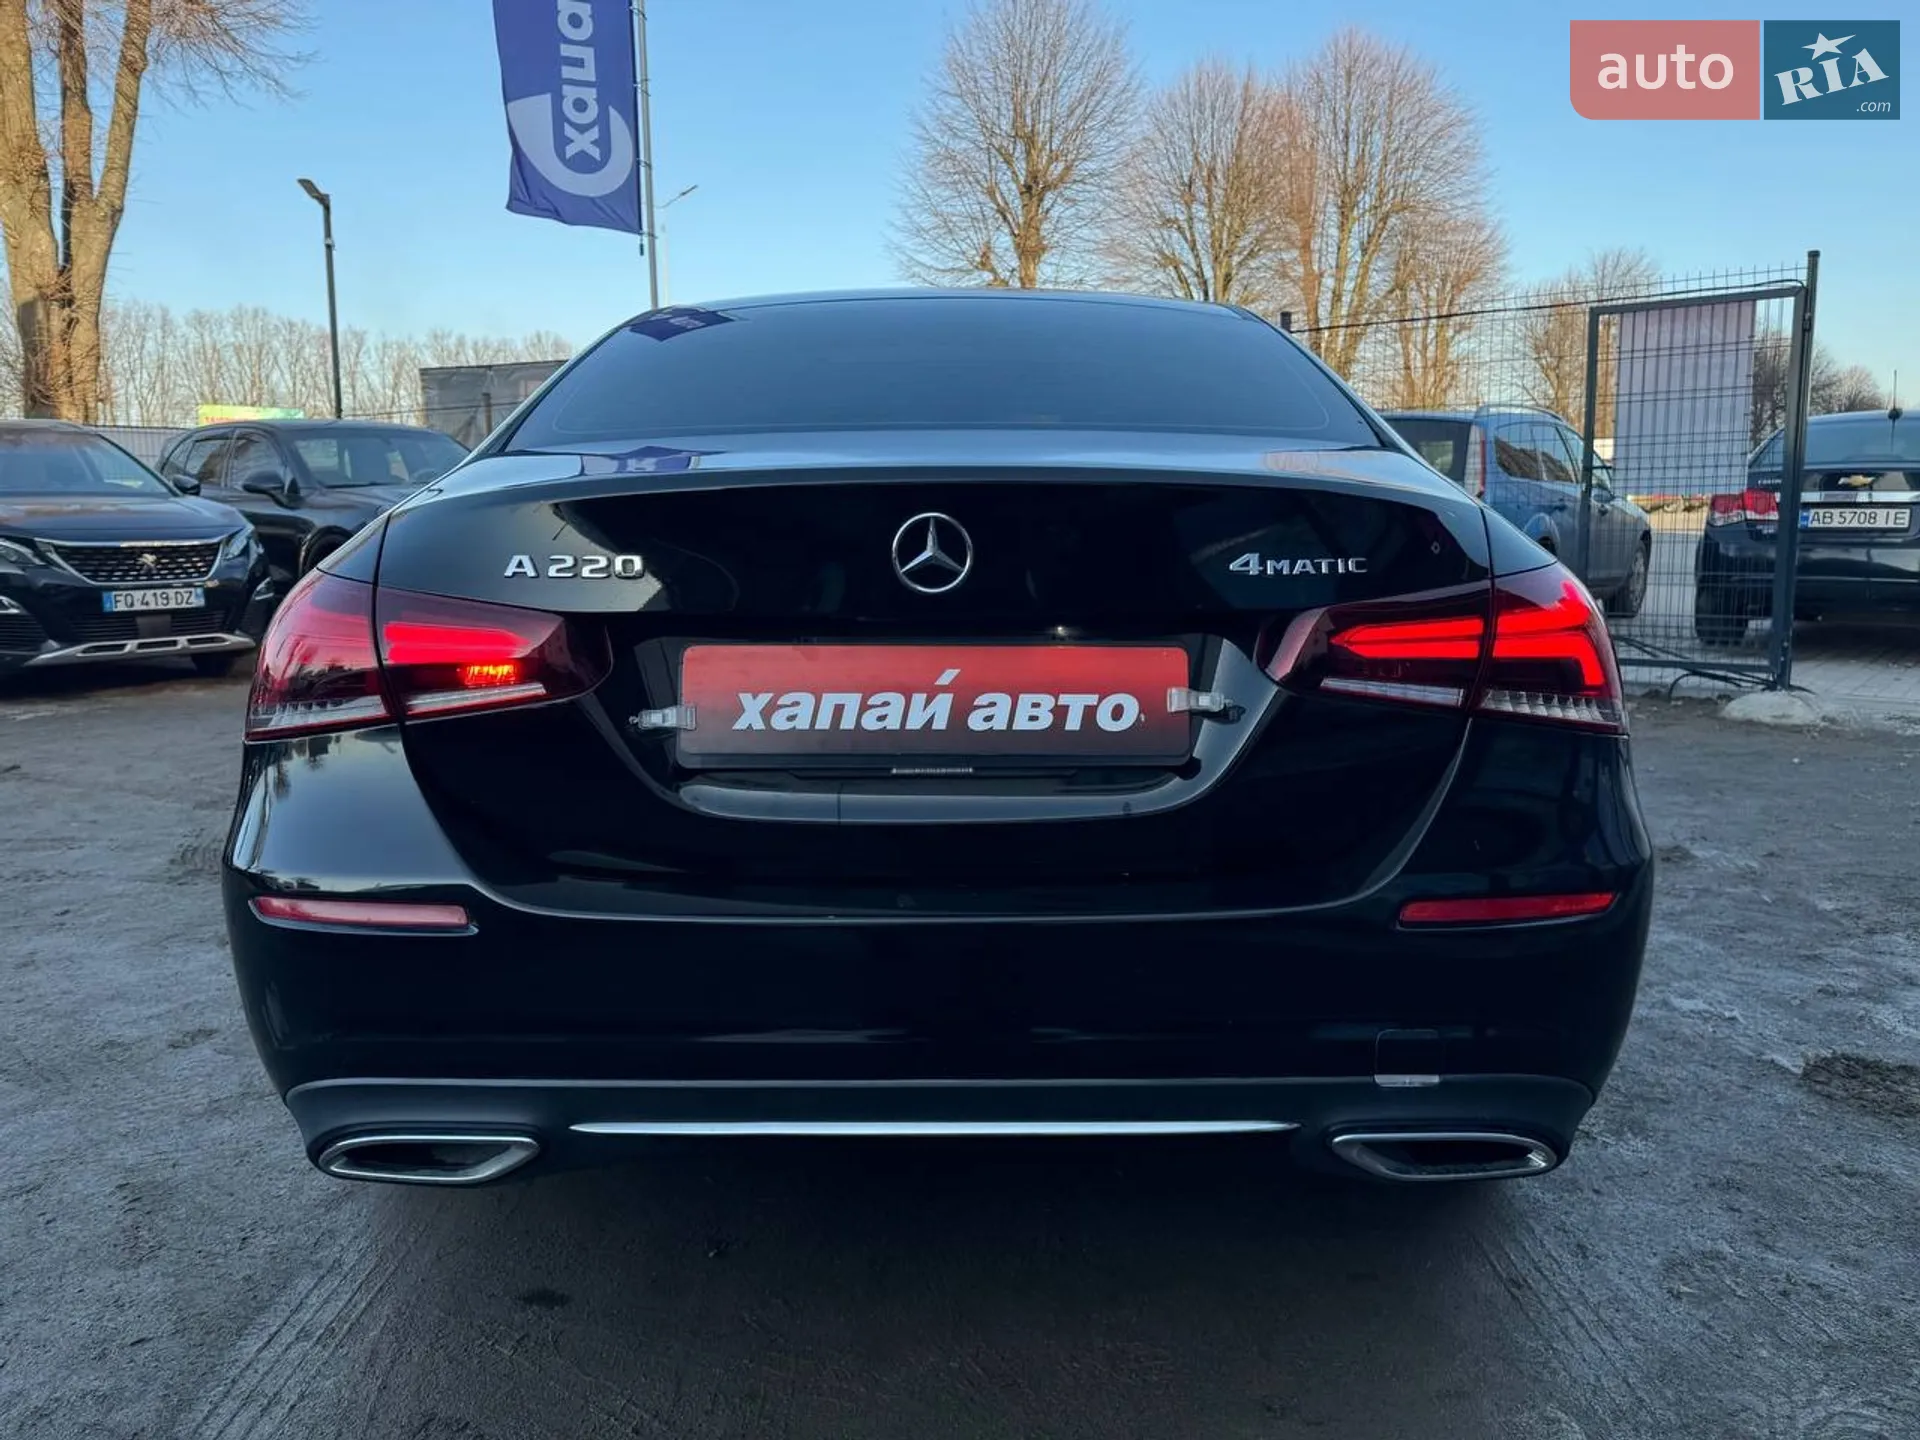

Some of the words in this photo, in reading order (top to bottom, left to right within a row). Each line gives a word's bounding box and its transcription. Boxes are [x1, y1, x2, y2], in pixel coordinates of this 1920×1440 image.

[1810, 510, 1834, 525] AB
[1837, 511, 1878, 526] 5708
[1885, 511, 1907, 526] IE
[504, 554, 539, 578] A
[547, 554, 644, 578] 220
[1229, 552, 1368, 576] 4MATIC
[967, 692, 1140, 732] авто
